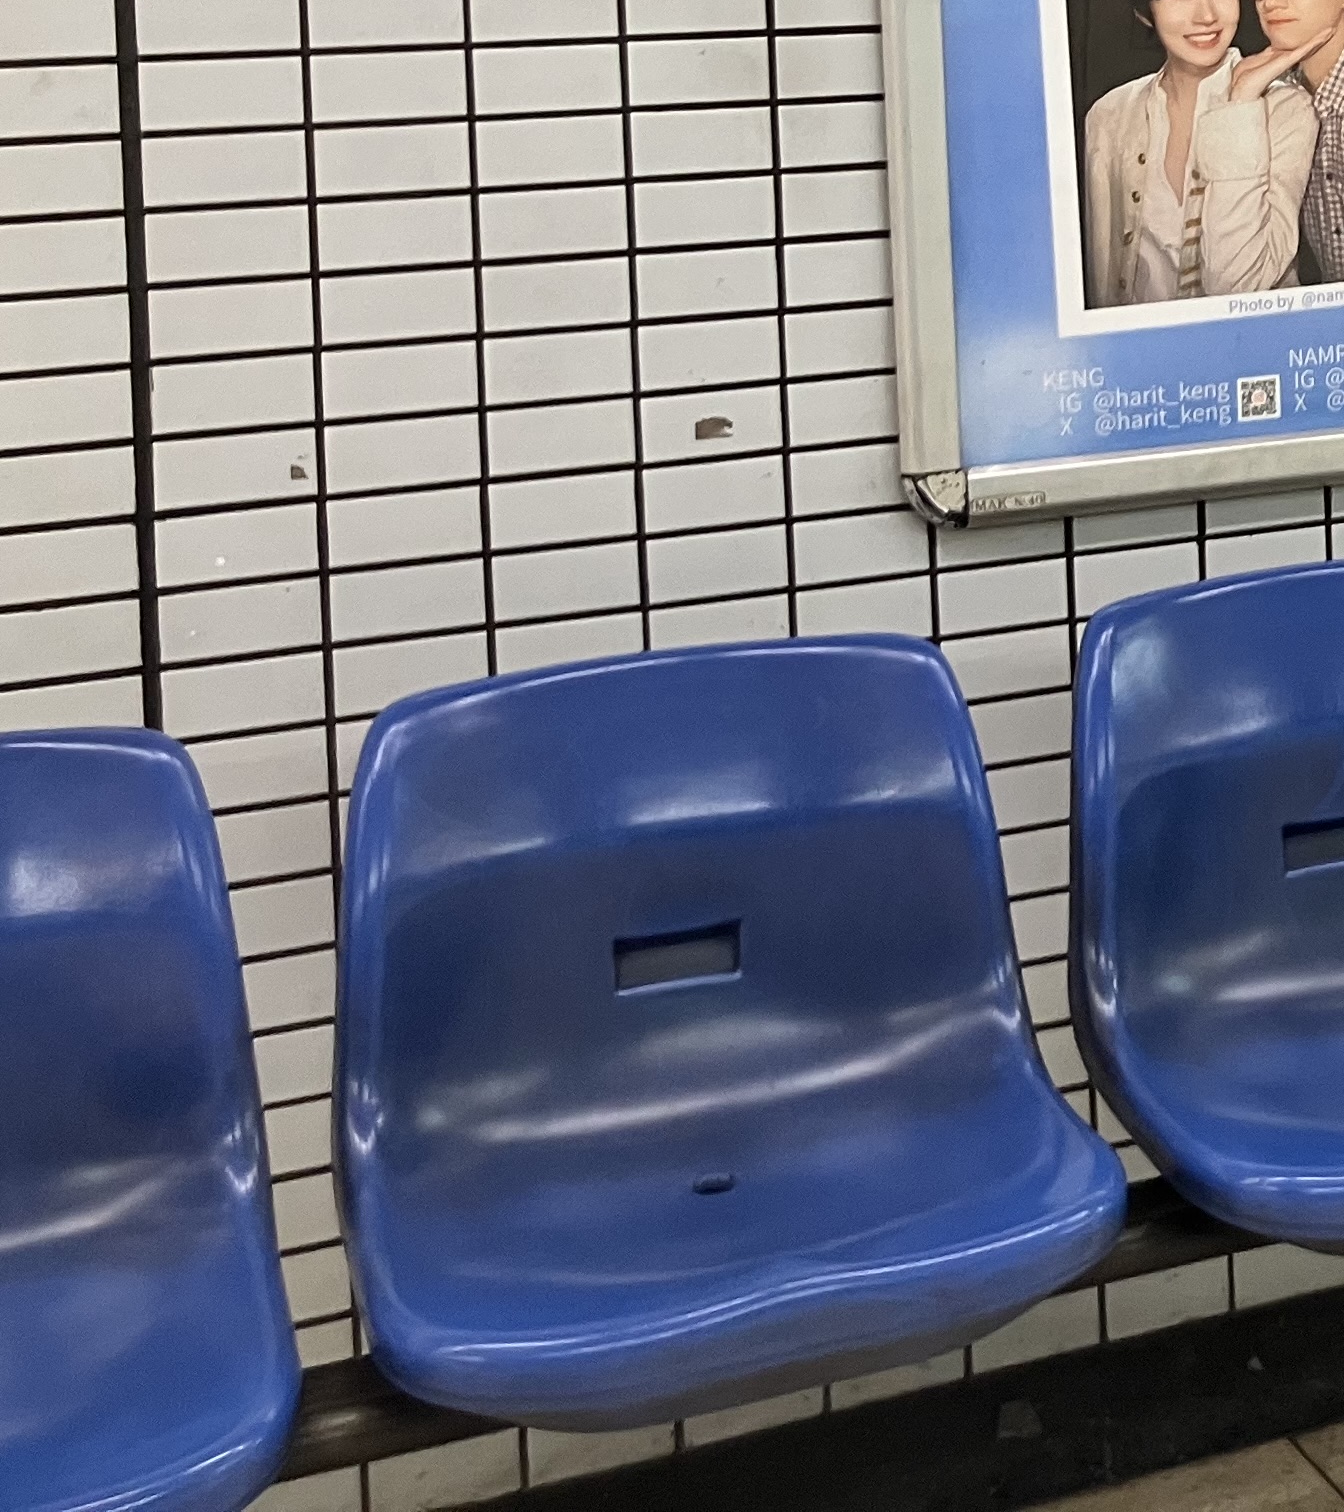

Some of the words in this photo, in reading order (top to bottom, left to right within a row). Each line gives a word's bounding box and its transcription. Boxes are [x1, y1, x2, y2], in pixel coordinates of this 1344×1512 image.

[1229, 299, 1273, 314] Photo
[1277, 294, 1294, 311] by
[1043, 367, 1105, 391] KENG
[1294, 369, 1315, 390] IG
[1059, 392, 1082, 414] IG
[1093, 381, 1231, 414] @harit_keng
[1294, 392, 1308, 413] X
[1060, 416, 1074, 436] X
[1095, 404, 1232, 436] @harit_keng
